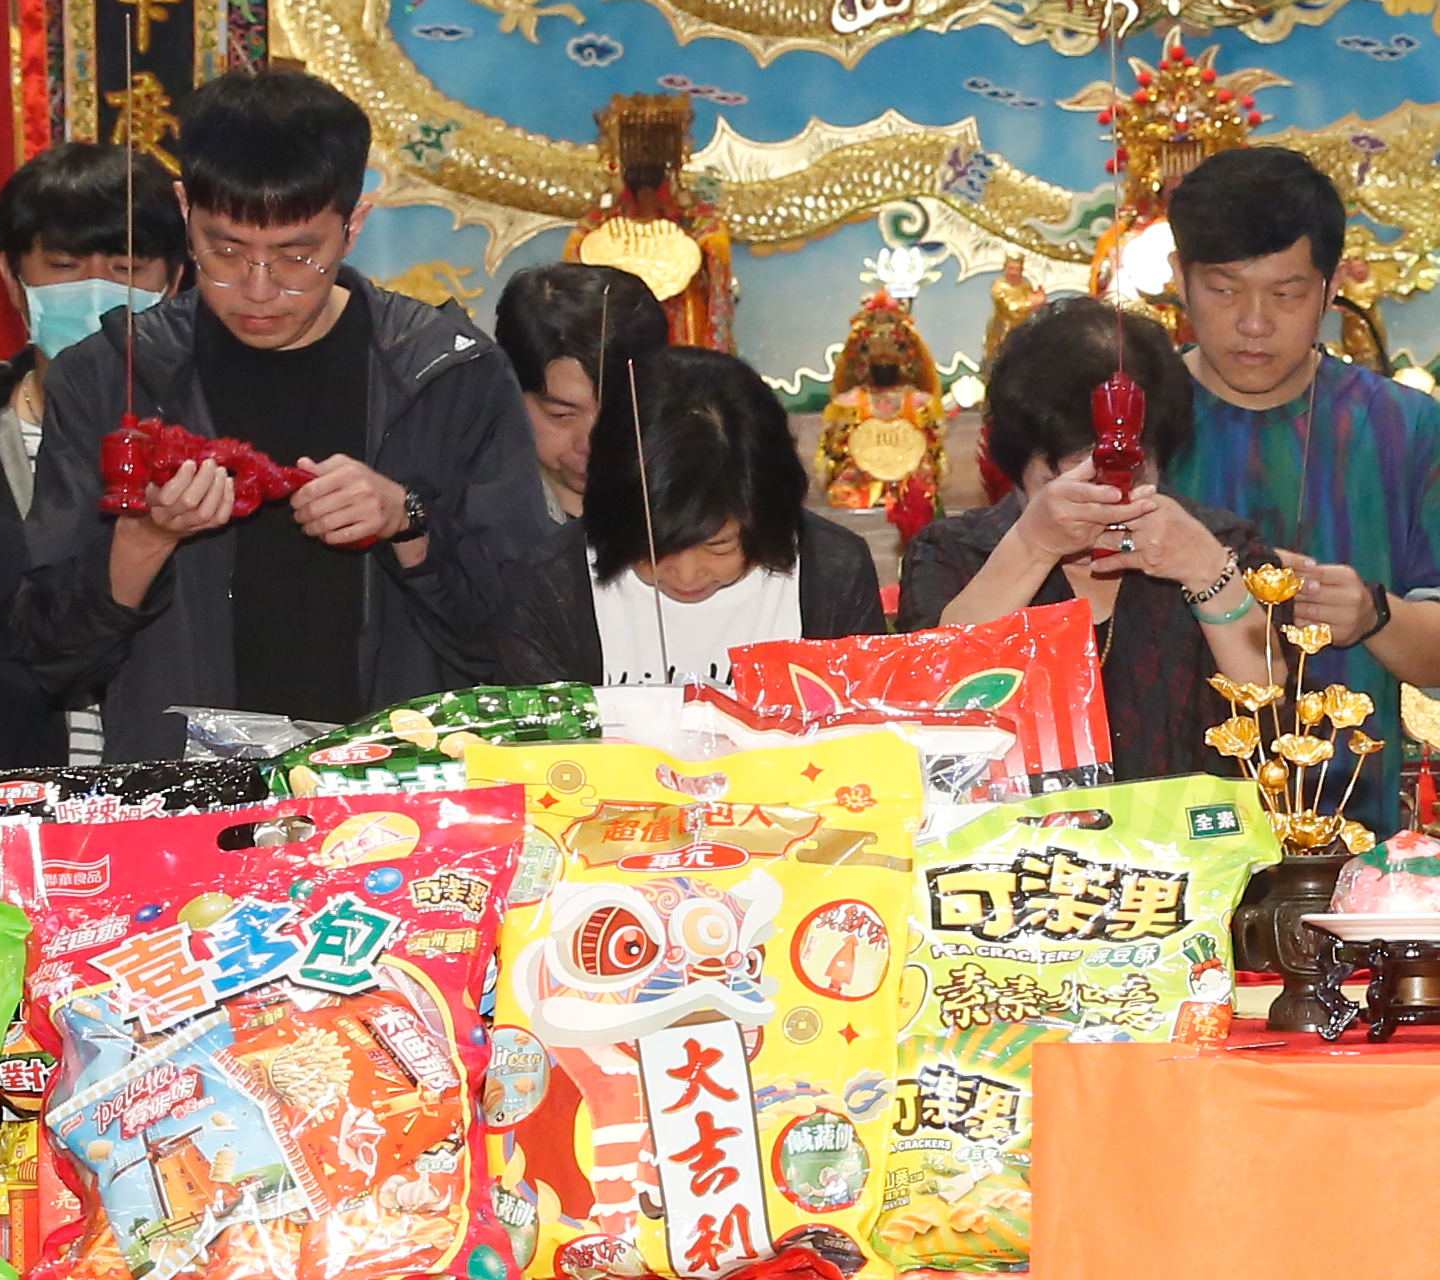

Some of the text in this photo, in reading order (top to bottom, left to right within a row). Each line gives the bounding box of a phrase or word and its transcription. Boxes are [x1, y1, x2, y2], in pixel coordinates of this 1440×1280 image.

[1194, 810, 1238, 832] 全素
[649, 846, 716, 869] 華元
[935, 851, 1187, 938] 可樂果
[93, 898, 396, 1030] 喜多包
[973, 944, 1084, 965] CRACKERS
[665, 1037, 756, 1276] 大吉利
